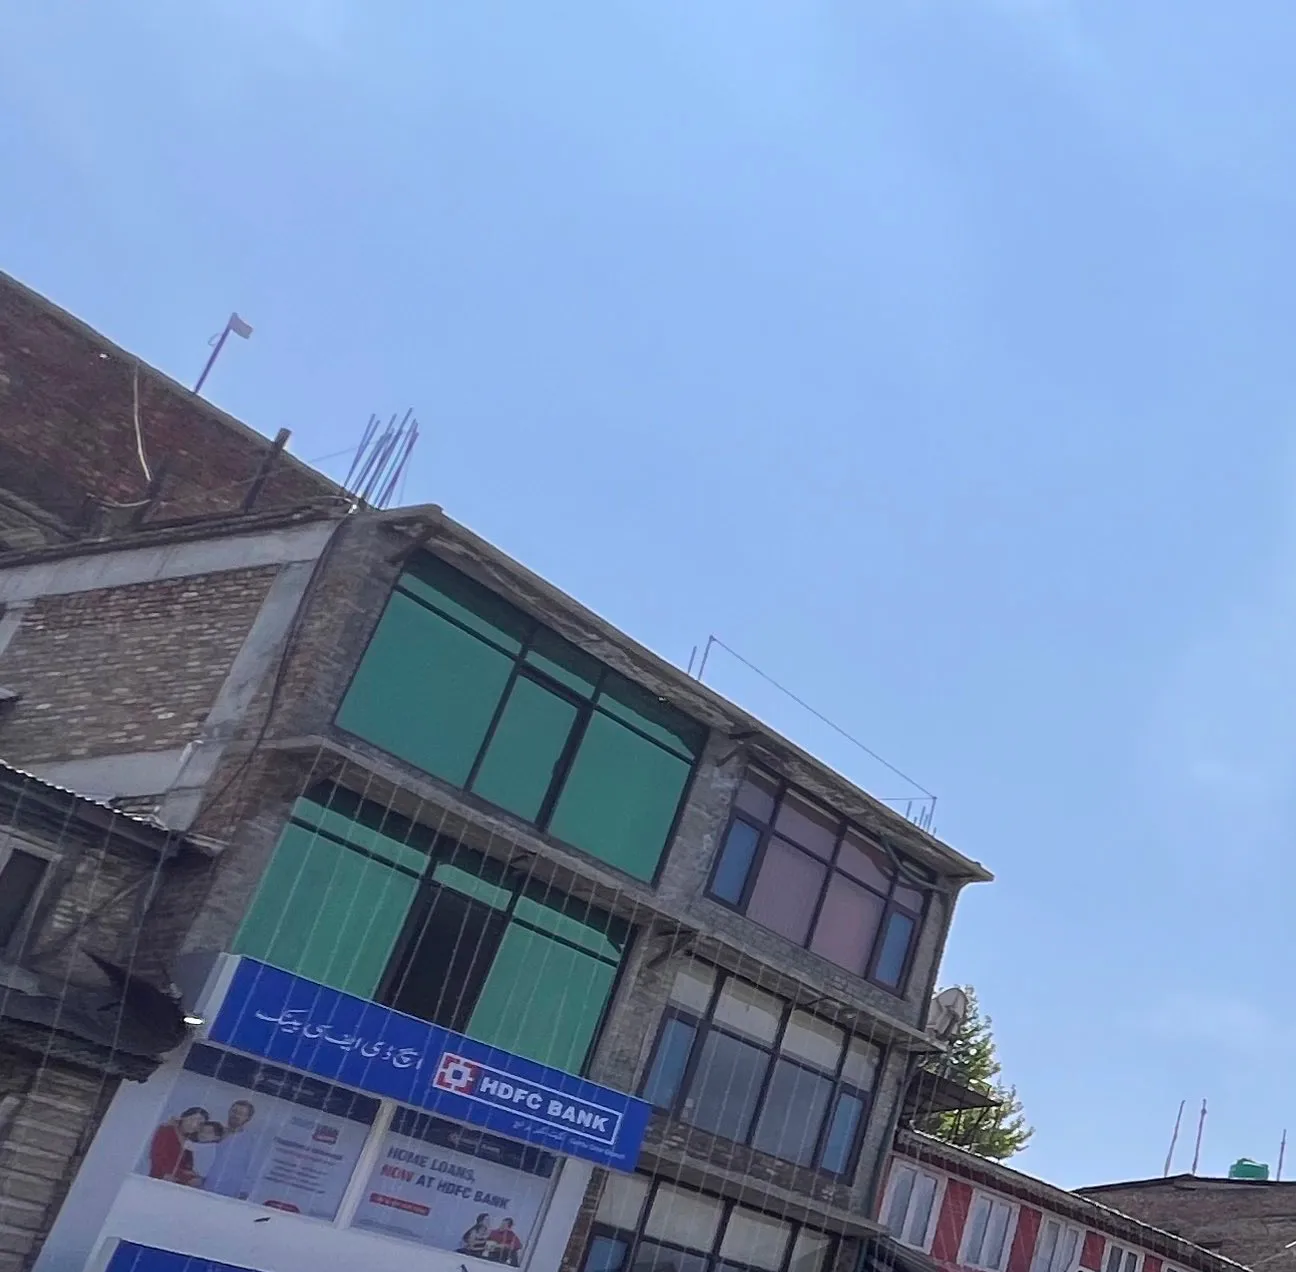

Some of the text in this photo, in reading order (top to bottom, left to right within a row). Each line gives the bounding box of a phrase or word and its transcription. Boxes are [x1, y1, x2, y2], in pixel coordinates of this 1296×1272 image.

[479, 1075, 544, 1110] HDFC
[546, 1099, 610, 1133] BANK
[387, 1146, 428, 1168] HOME
[380, 1163, 512, 1210] NOW AT HDFC BANK
